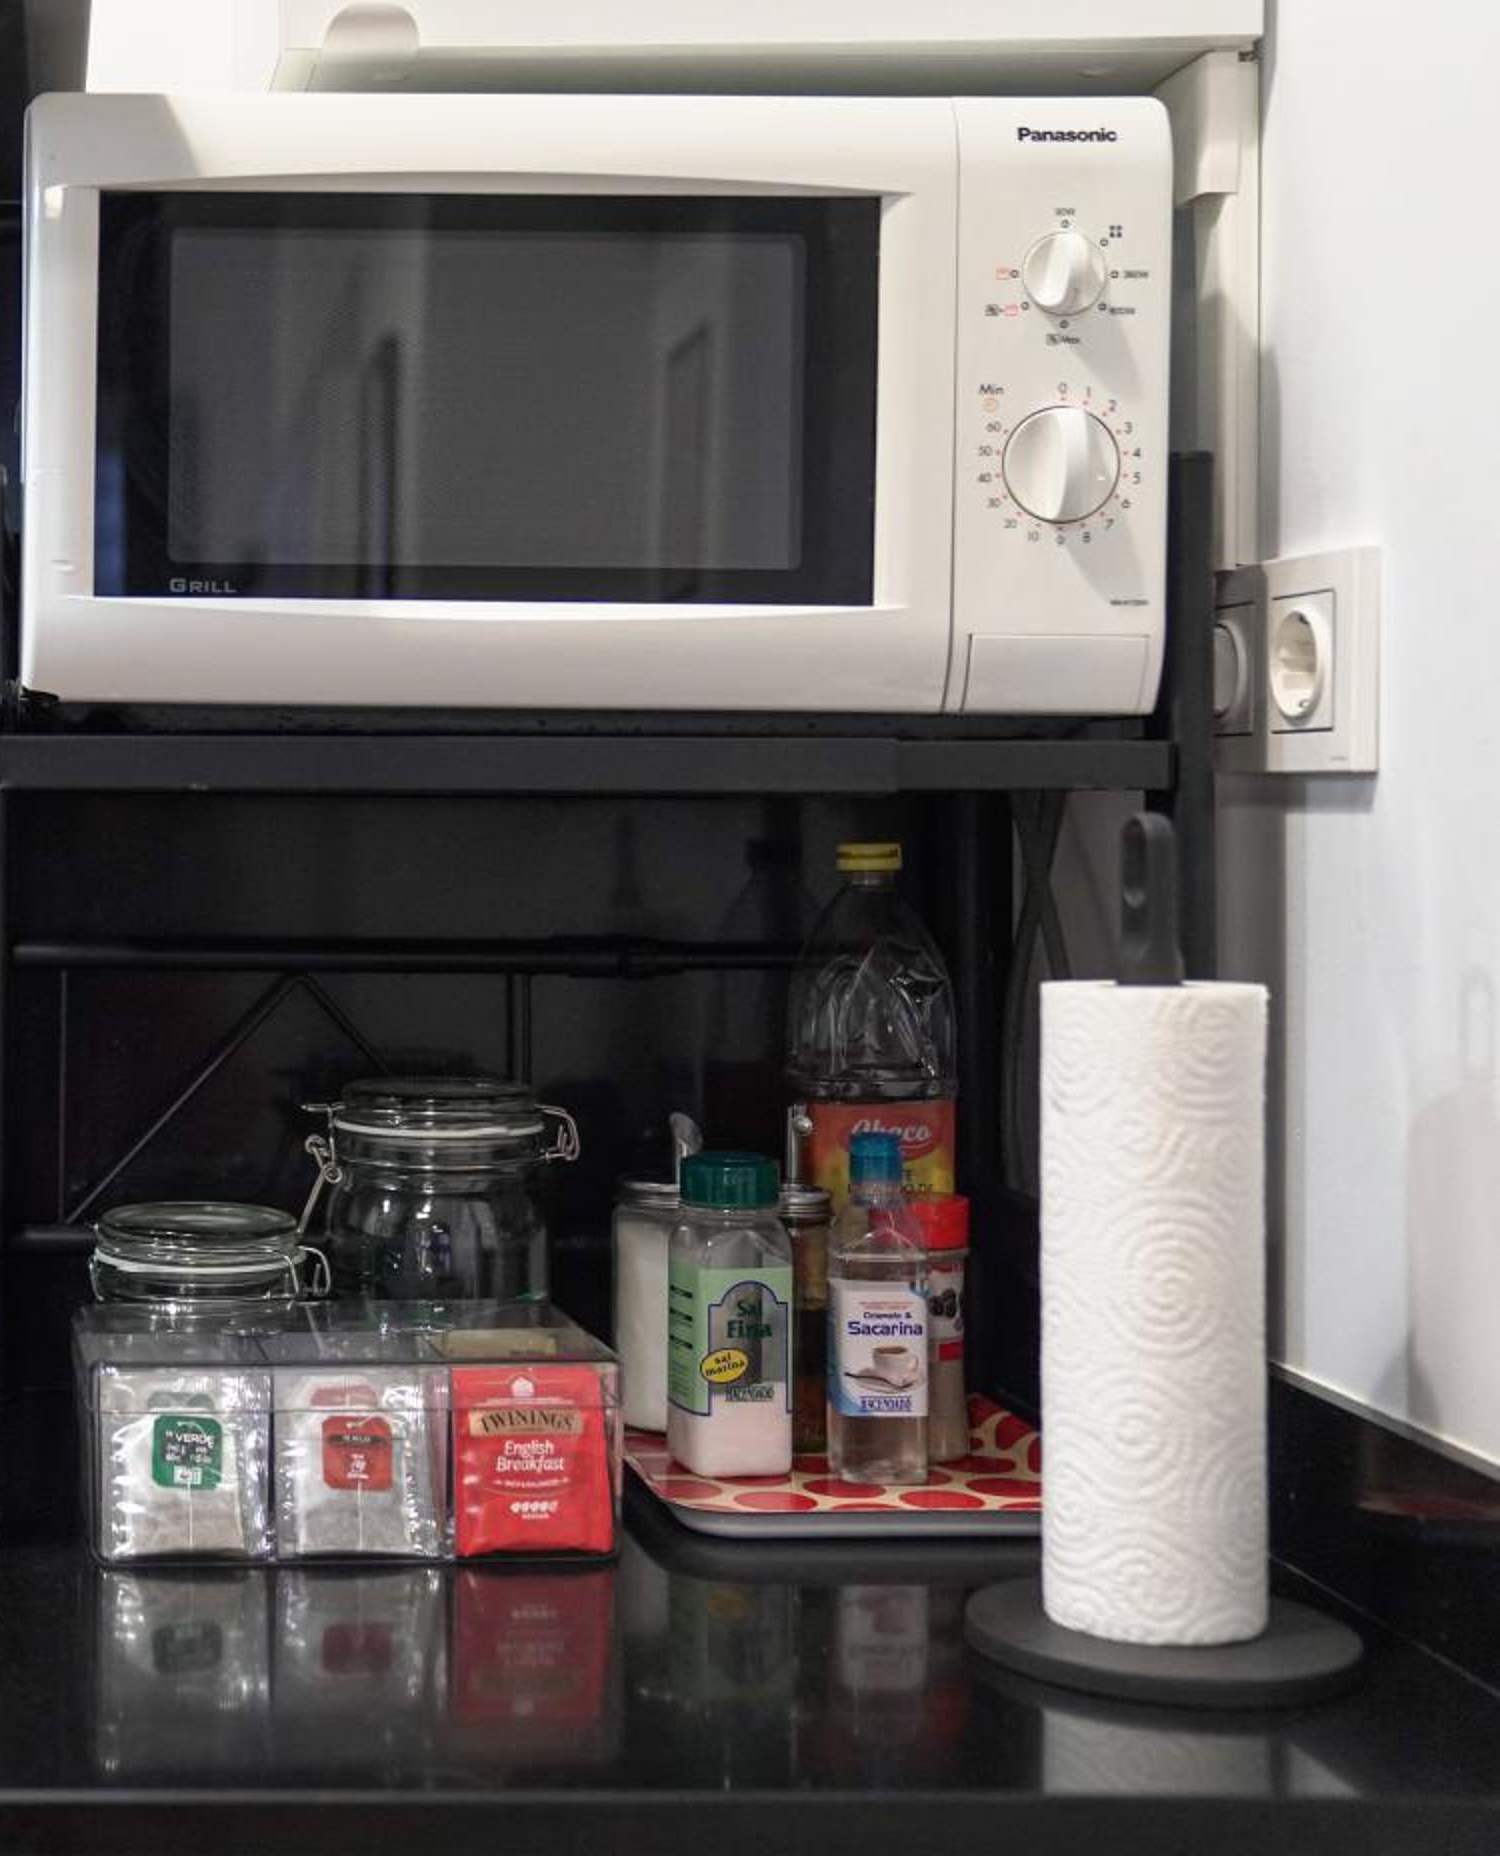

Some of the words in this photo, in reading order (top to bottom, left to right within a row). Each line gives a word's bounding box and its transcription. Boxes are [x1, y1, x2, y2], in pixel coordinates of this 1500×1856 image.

[1017, 127, 1118, 142] Panasonic
[979, 384, 1005, 395] Min
[1132, 448, 1141, 458] 4
[169, 577, 237, 593] GRILL
[737, 1300, 762, 1317] Sal
[726, 1319, 773, 1339] Fina
[847, 1321, 924, 1337] Sacarina
[480, 1409, 575, 1434] TWININGS
[503, 1440, 555, 1459] English
[495, 1456, 565, 1473] Breakfast
